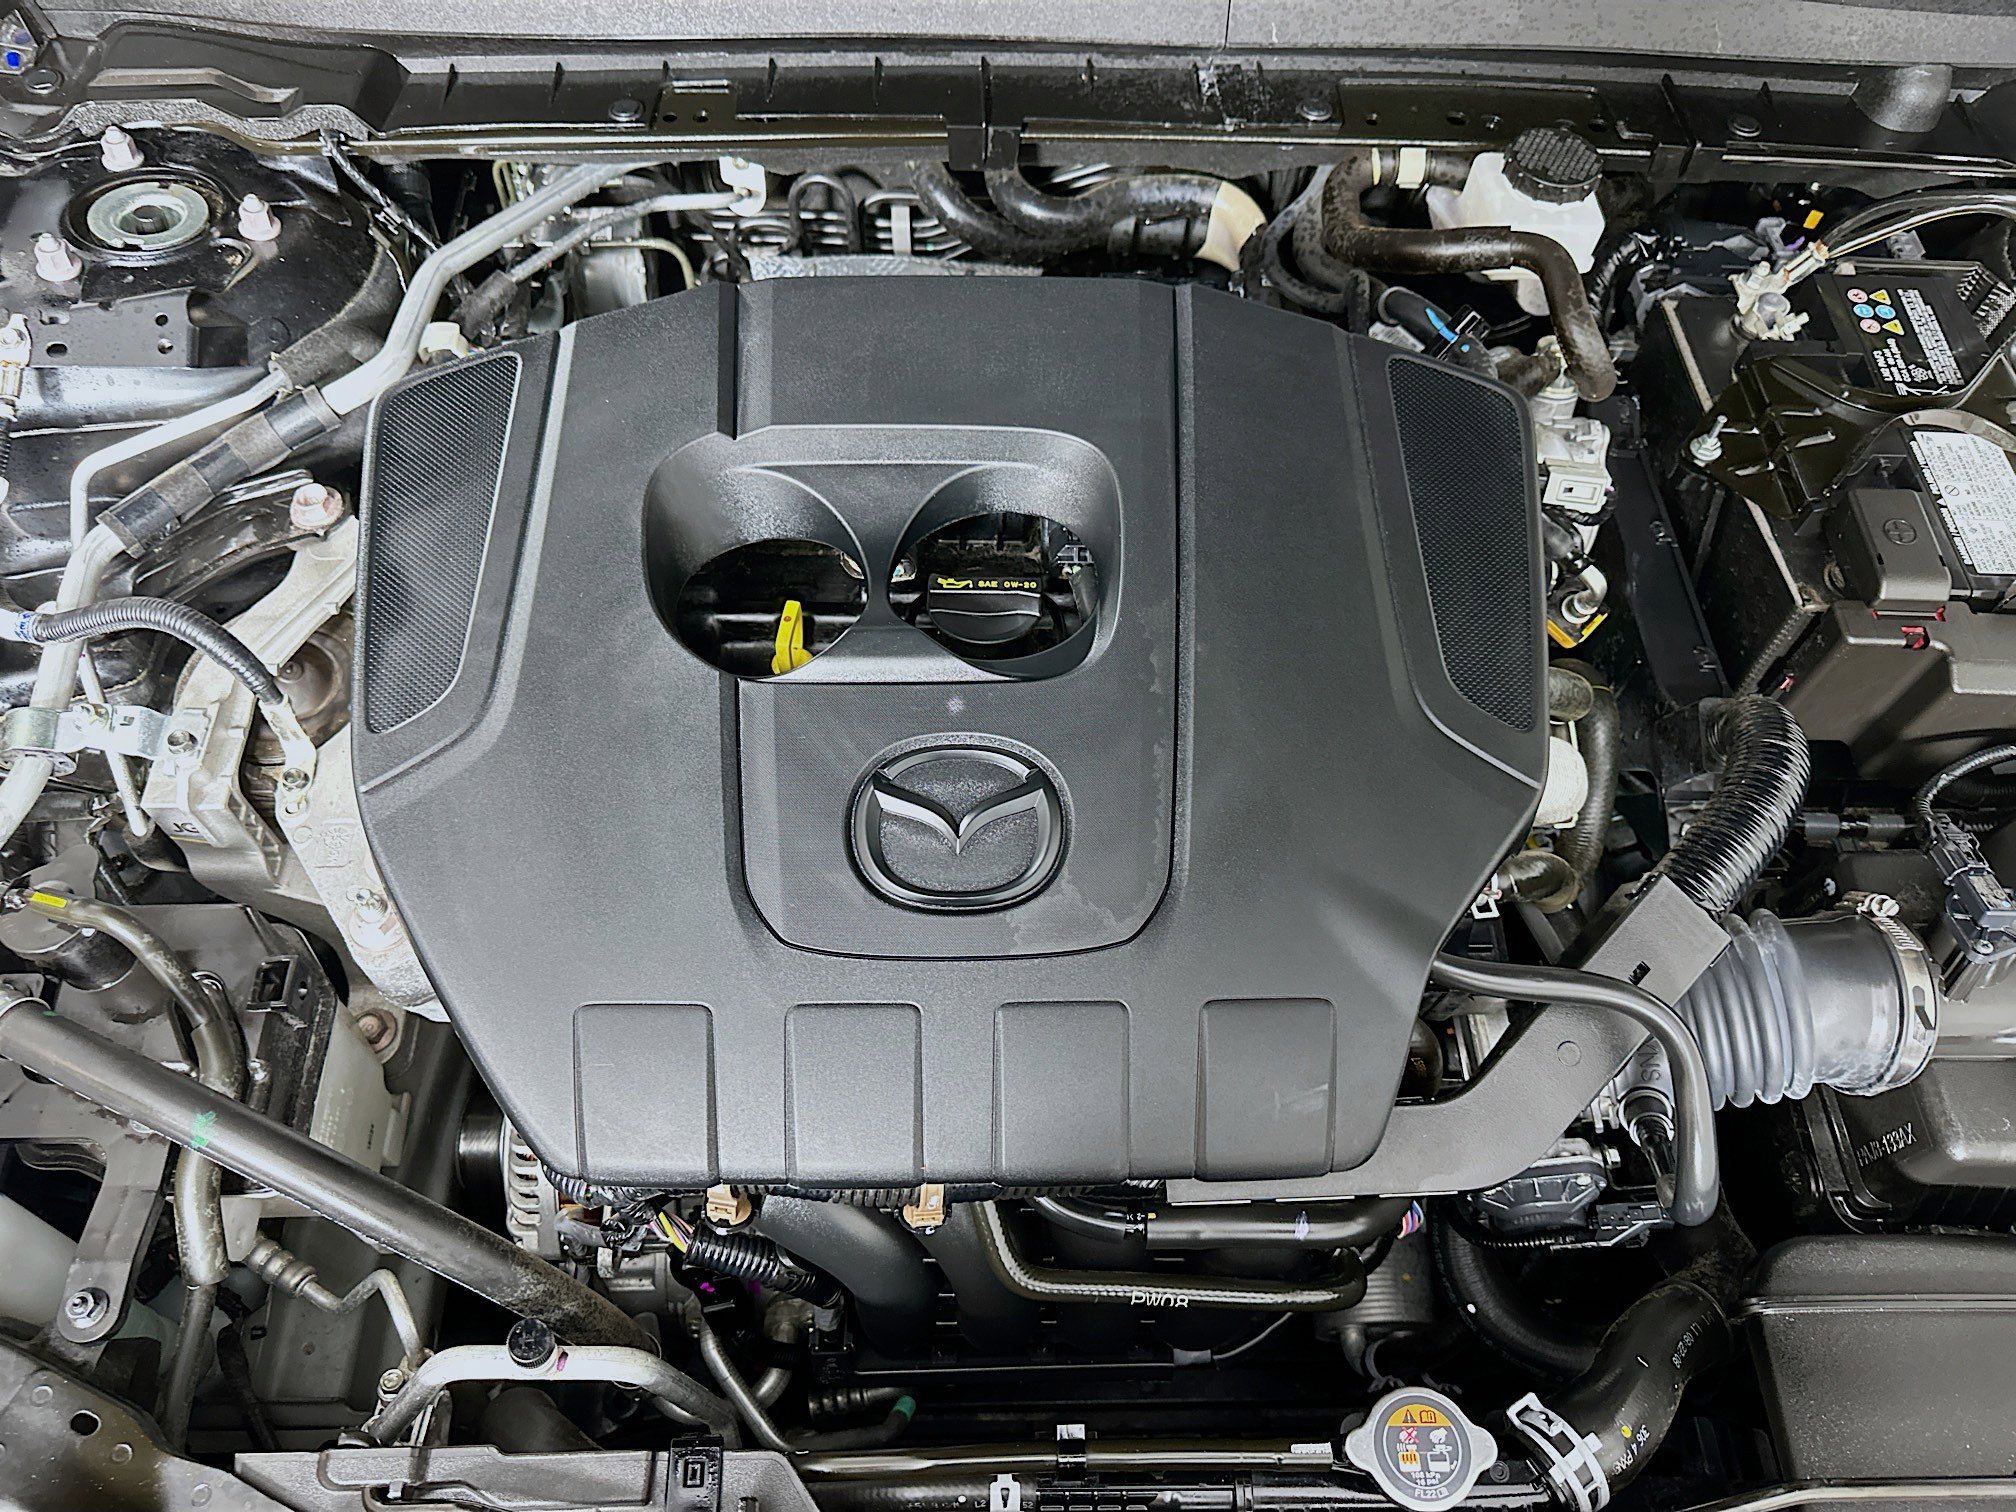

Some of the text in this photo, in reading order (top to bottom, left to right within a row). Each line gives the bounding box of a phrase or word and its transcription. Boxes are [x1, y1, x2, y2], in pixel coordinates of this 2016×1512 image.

[978, 580, 1037, 589] SAE 0W-20
[173, 822, 200, 834] JG
[1414, 1488, 1437, 1499] FL22
